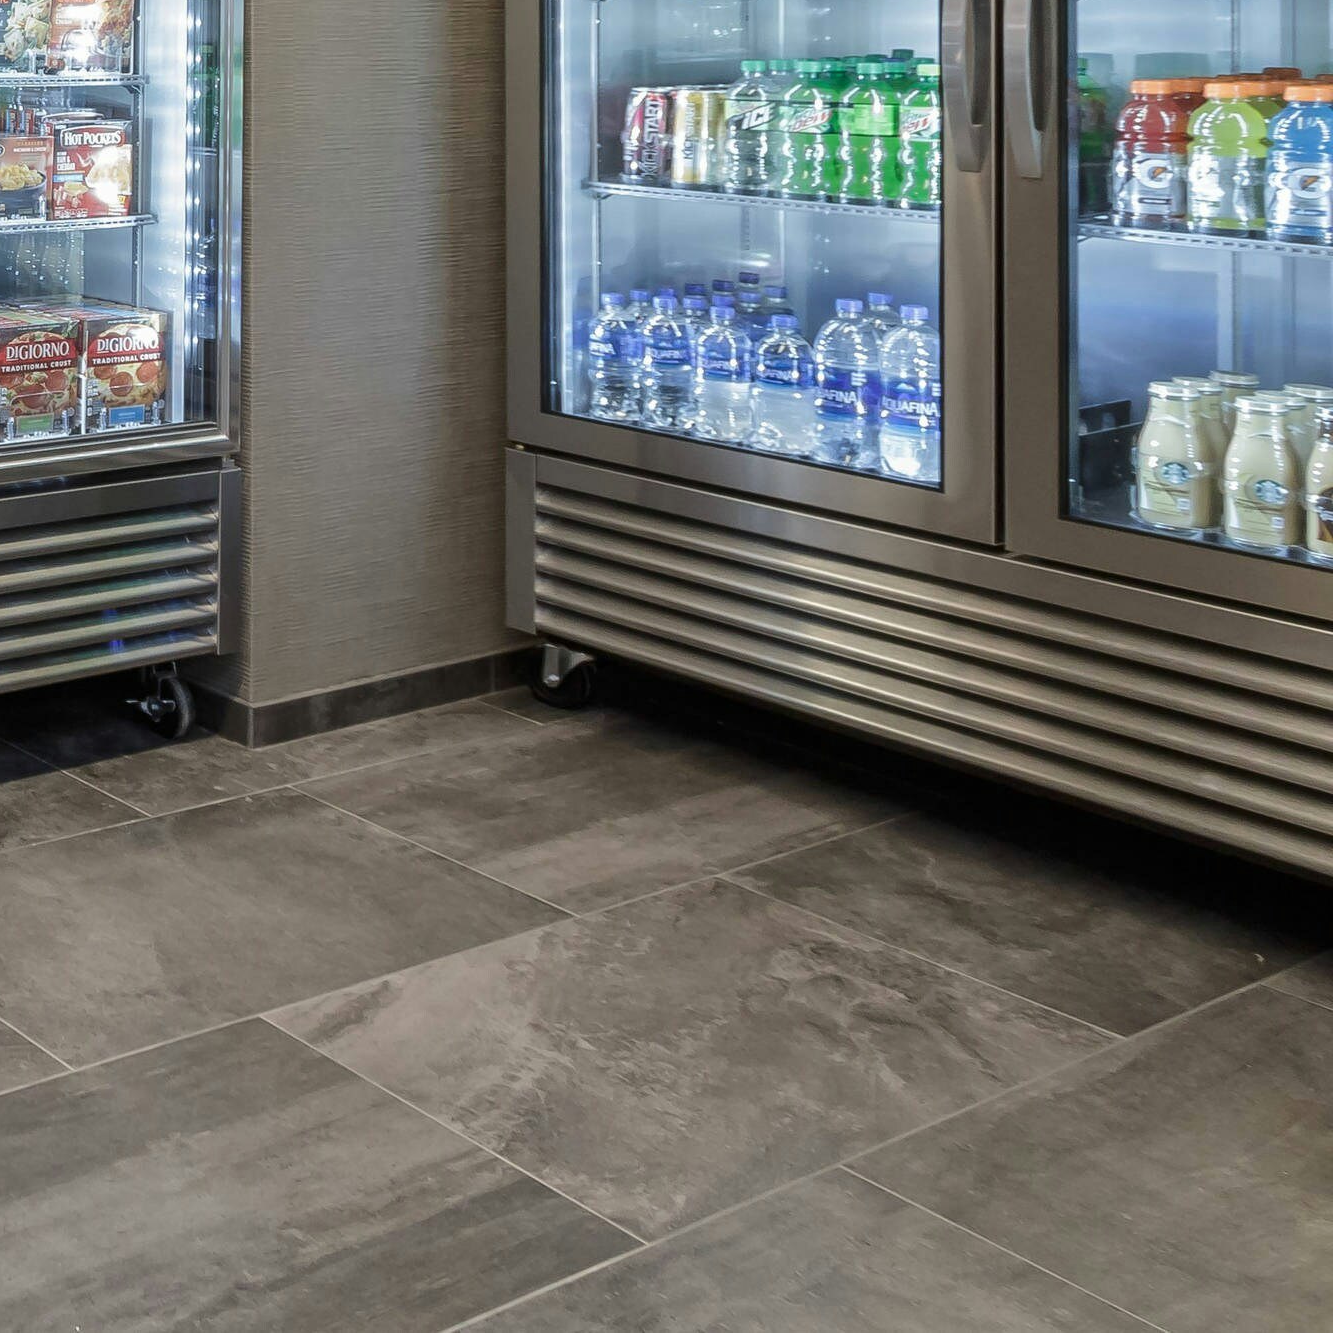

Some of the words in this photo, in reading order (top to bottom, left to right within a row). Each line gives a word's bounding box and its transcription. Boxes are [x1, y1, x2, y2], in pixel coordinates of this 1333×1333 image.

[64, 132, 83, 145] HOT
[83, 131, 122, 145] POCKETS
[92, 355, 139, 364] TRADITIONAL
[139, 352, 161, 362] CRUST
[1, 362, 49, 373] TRADITIONAL
[50, 360, 72, 368] CRUST
